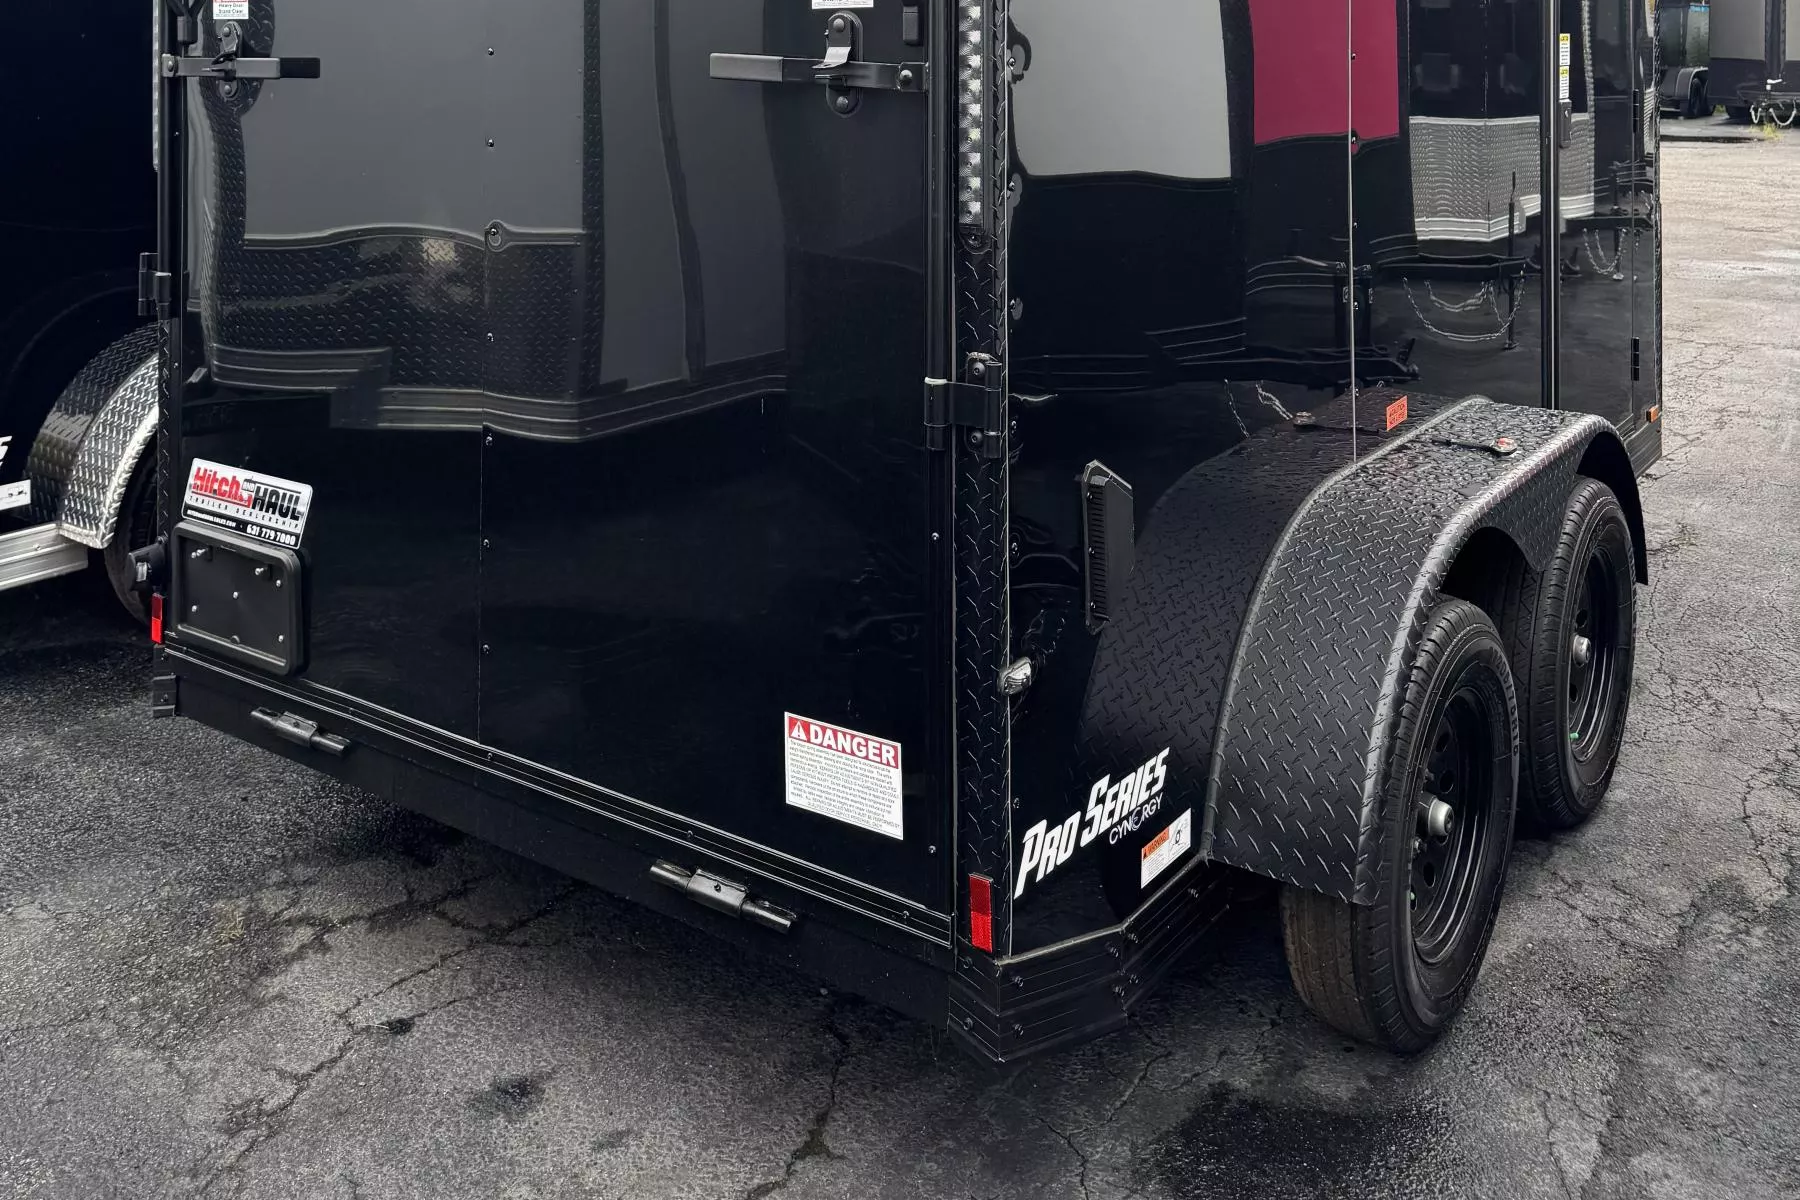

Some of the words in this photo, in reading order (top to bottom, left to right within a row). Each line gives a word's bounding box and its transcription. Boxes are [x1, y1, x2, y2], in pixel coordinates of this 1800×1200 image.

[192, 466, 241, 500] Hitch
[252, 485, 302, 521] HAUL
[809, 723, 897, 768] DANGER
[1014, 810, 1081, 900] PRO
[1080, 747, 1170, 847] SERIES
[1109, 792, 1164, 845] CYNERGY
